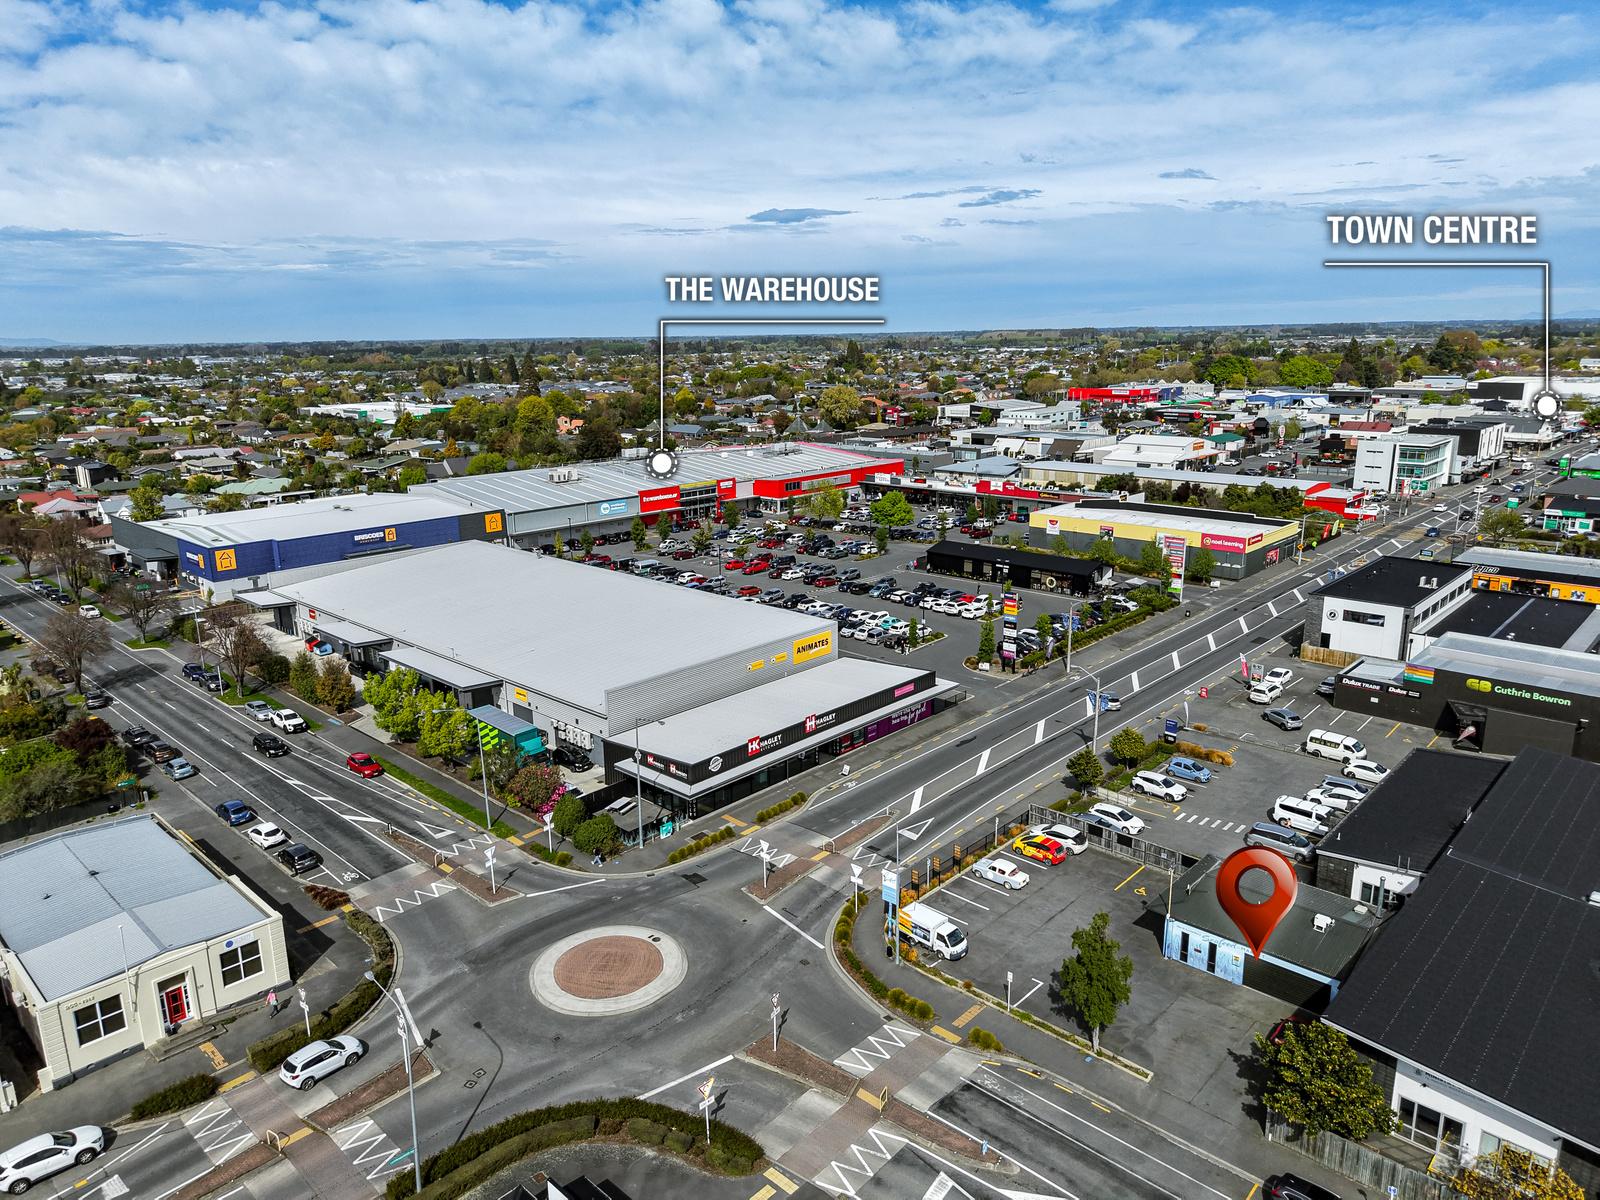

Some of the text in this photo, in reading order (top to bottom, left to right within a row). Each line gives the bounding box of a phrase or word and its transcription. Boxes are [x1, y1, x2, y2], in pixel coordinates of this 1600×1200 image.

[1224, 541, 1244, 549] leeming
[796, 638, 829, 654] ANIMATES
[1342, 678, 1381, 691] Dulux TRADE
[1388, 686, 1408, 695] Dulux
[1465, 678, 1492, 693] GB
[1494, 685, 1572, 706] Guthrie Bowron
[815, 712, 836, 725] HAGLEY
[748, 739, 760, 753] HK
[760, 734, 782, 747] HAGLEY
